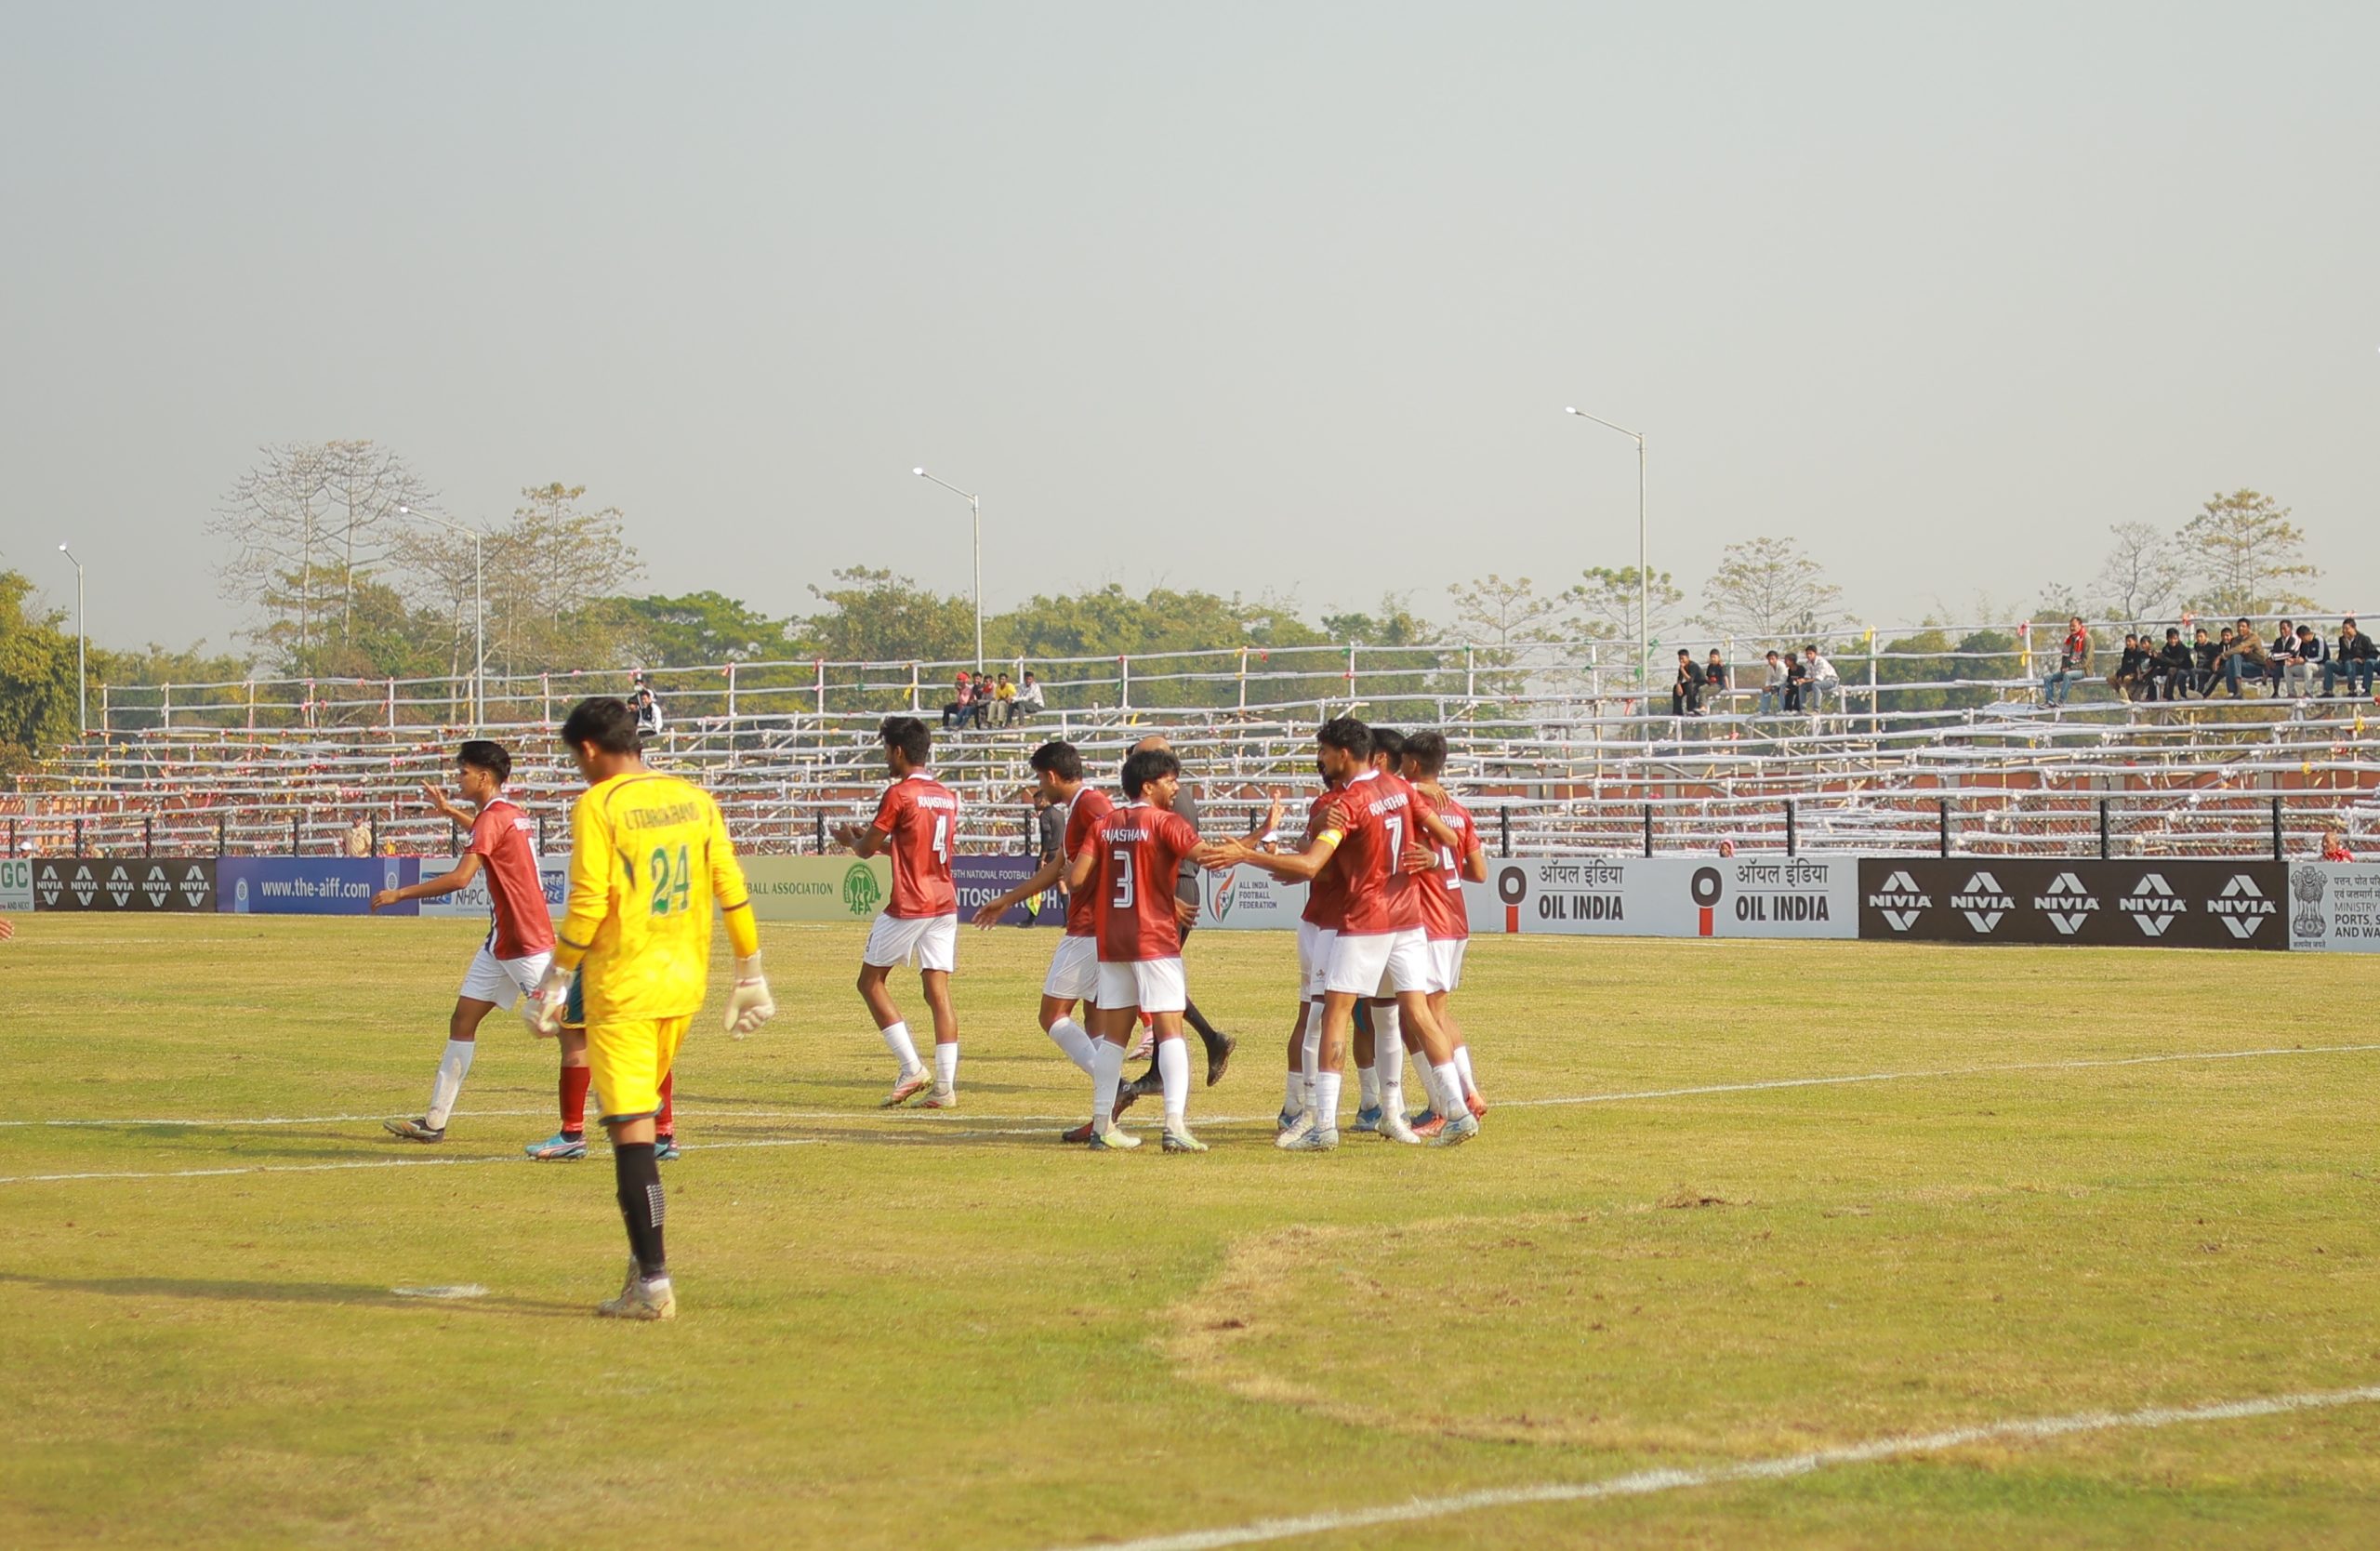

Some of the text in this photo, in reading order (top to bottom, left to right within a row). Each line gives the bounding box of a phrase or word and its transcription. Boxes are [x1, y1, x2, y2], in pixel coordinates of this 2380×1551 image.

[932, 815, 947, 865] 4
[1384, 816, 1402, 875] 7
[1, 861, 28, 889] GC
[966, 869, 998, 880] NATIONAL
[998, 870, 1031, 880] FOOTBALL
[1113, 850, 1133, 908] 3
[1540, 859, 1624, 887] ऑयल इंडिया
[1736, 858, 1829, 887] ऑयल इंडिया
[36, 881, 64, 891] NIVIA
[71, 881, 99, 892] NIVIA
[106, 882, 135, 892] NIVIA
[142, 882, 172, 892] NIVIA
[179, 882, 210, 892] NIVIA
[261, 877, 370, 898] www.the-aiff.com
[651, 845, 690, 916] 24
[744, 882, 833, 895] BALL ASSOCIATION
[456, 889, 484, 906] NHPC
[955, 888, 1000, 907] NTOSH
[1869, 895, 1932, 908] NIVIA
[1950, 895, 2016, 909] NIVIA
[2034, 897, 2100, 910] NIVIA
[1540, 895, 1624, 920] OIL INDIA
[1736, 896, 1829, 921] OIL INDIA
[2120, 898, 2187, 912] NIVIA
[2207, 900, 2277, 913] NIVIA
[2334, 902, 2377, 912] MINISTRY
[2334, 914, 2373, 926] PORTS,
[2334, 927, 2360, 938] AND
